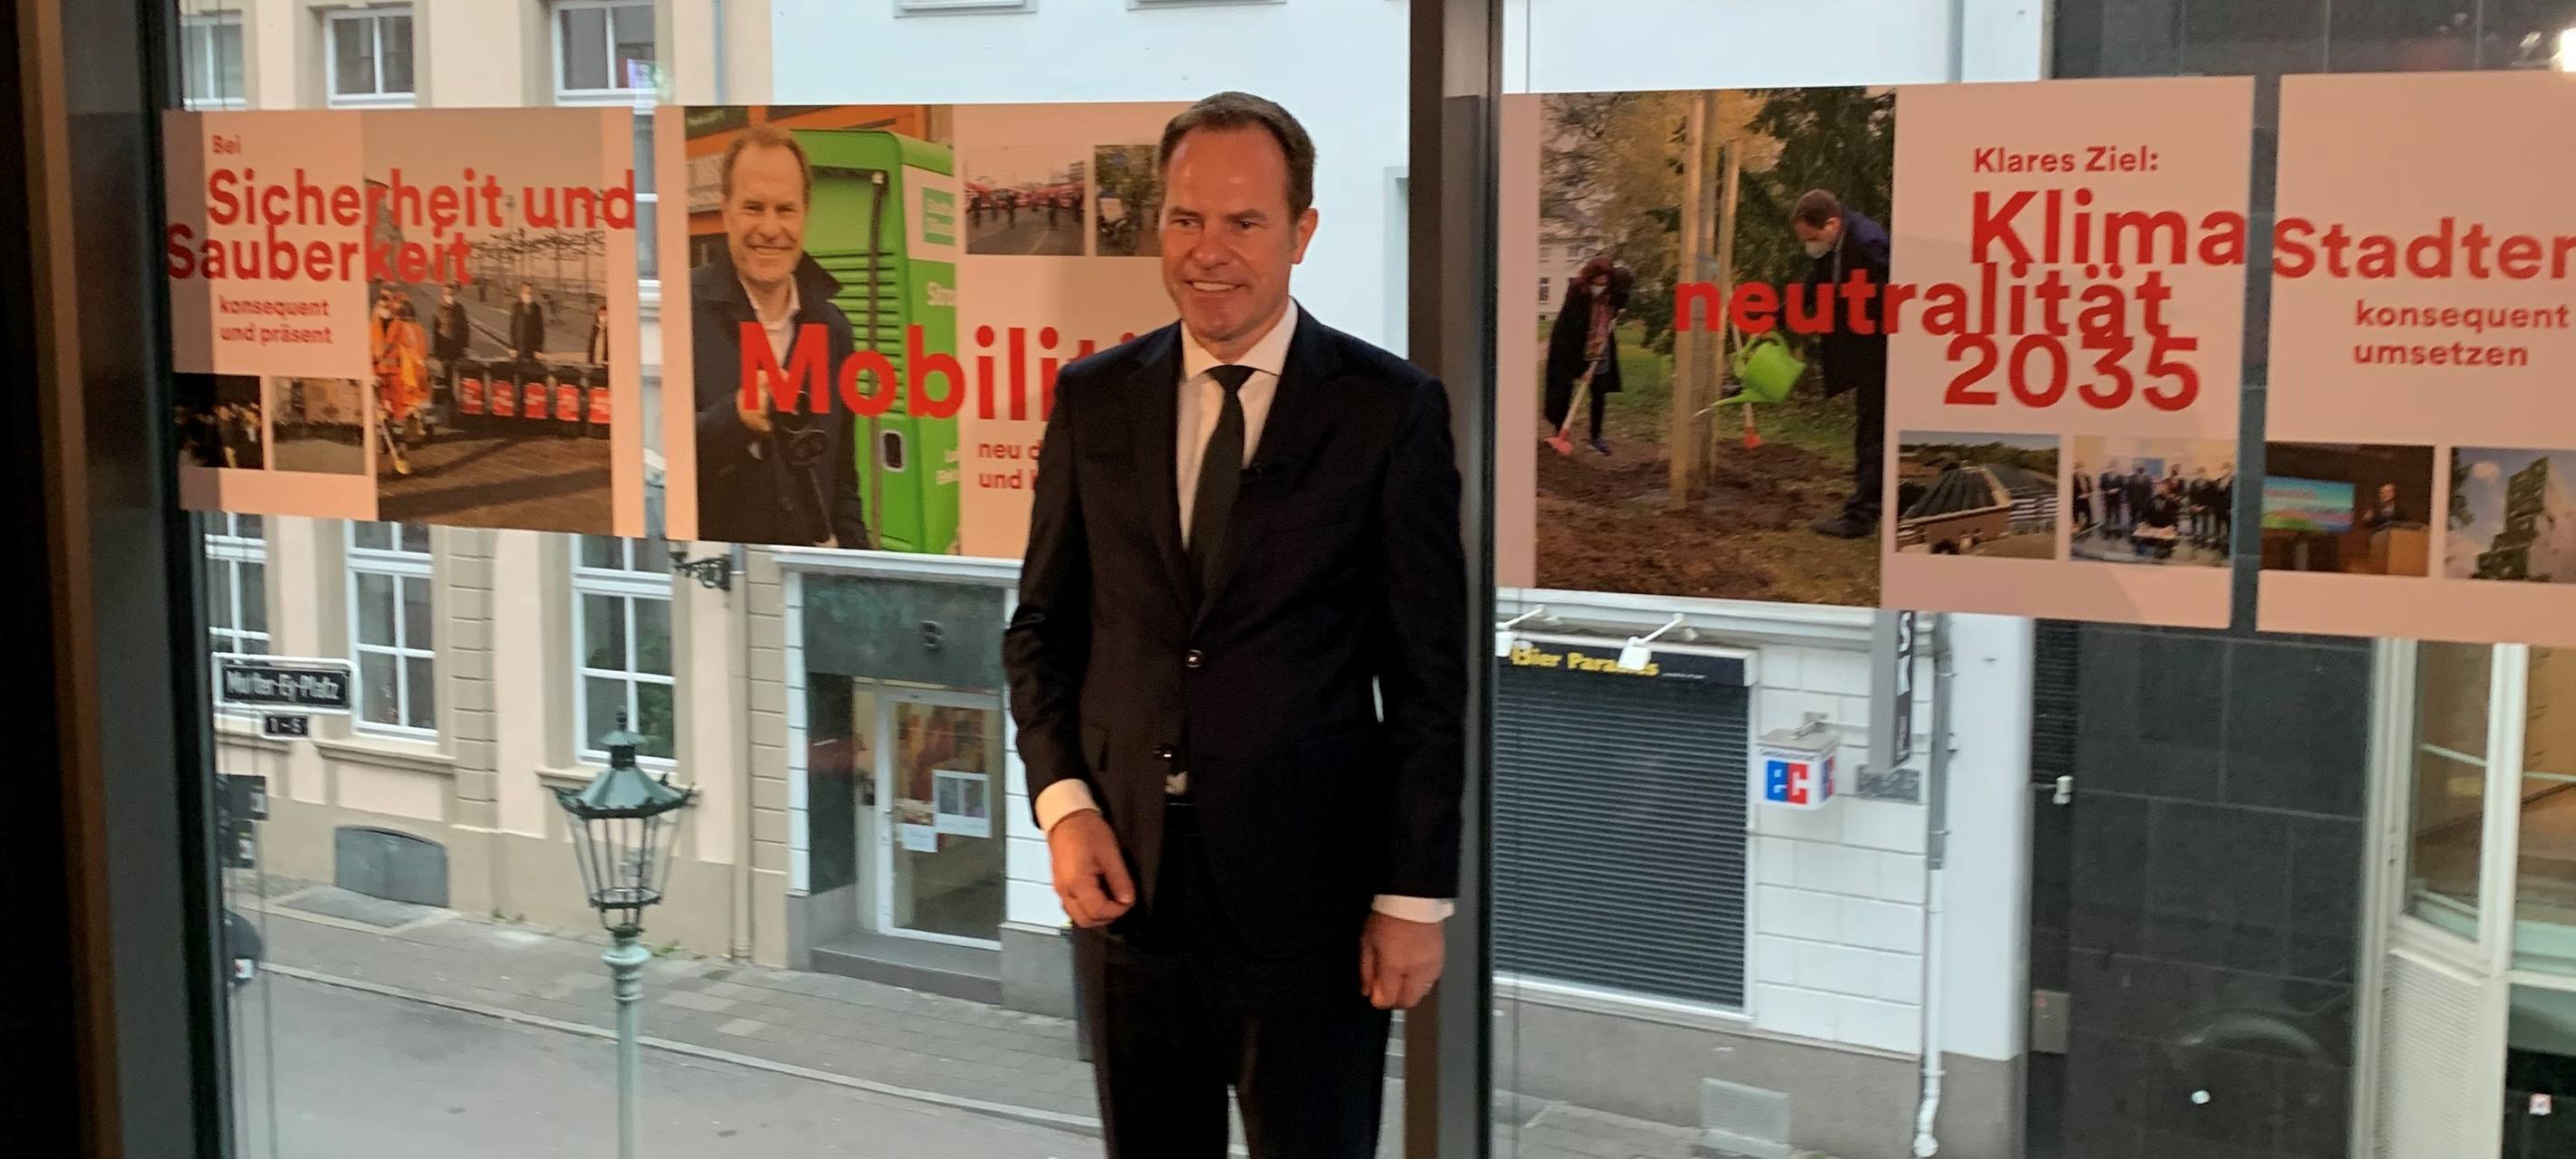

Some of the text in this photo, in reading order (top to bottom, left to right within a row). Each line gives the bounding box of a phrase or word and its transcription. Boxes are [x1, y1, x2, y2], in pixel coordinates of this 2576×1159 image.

[212, 135, 241, 155] Bei
[1974, 145, 2159, 173] Klares Ziel:
[207, 168, 635, 230] Sicherheit und
[1971, 187, 2247, 265] Klima
[168, 222, 473, 285] Sauberkeit
[218, 295, 331, 321] konsequent
[1674, 260, 2172, 338] neutralität
[2355, 300, 2570, 332] konsequent
[220, 323, 332, 346] und präsent
[2355, 340, 2528, 367] umsetzen
[737, 321, 1138, 420] Mobili
[1943, 331, 2199, 411] 2035
[978, 443, 1021, 461] neu
[978, 469, 1023, 489] und
